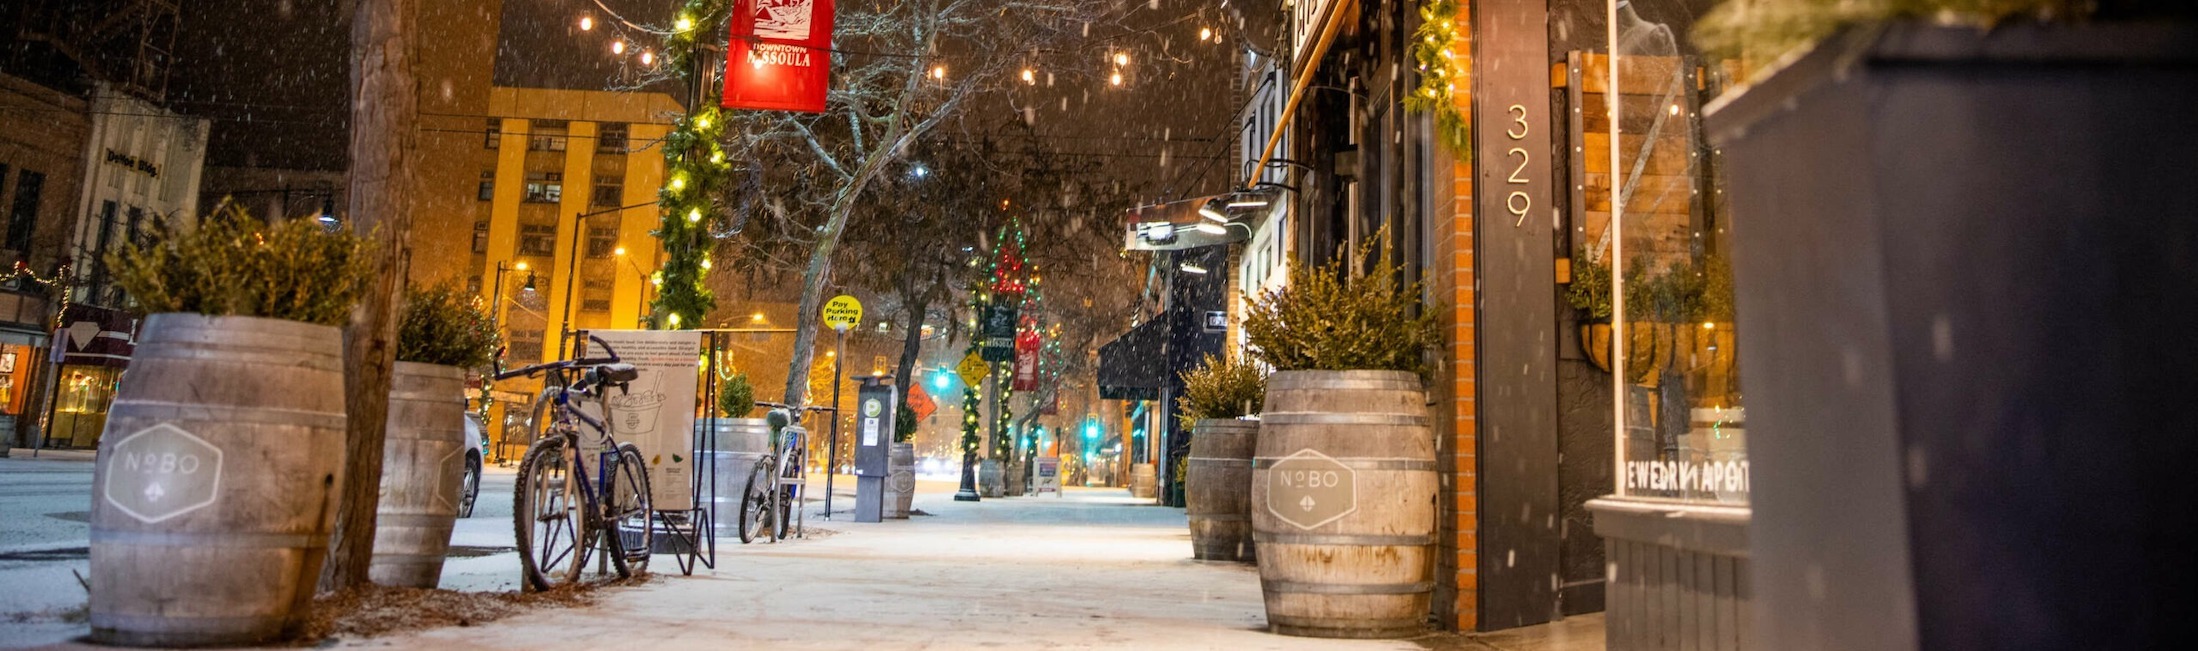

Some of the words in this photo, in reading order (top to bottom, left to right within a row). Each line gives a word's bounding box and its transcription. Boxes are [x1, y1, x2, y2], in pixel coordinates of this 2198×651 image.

[753, 43, 807, 53] DOWNTOWN
[747, 50, 810, 67] MSSOULA
[1507, 104, 1531, 227] 329
